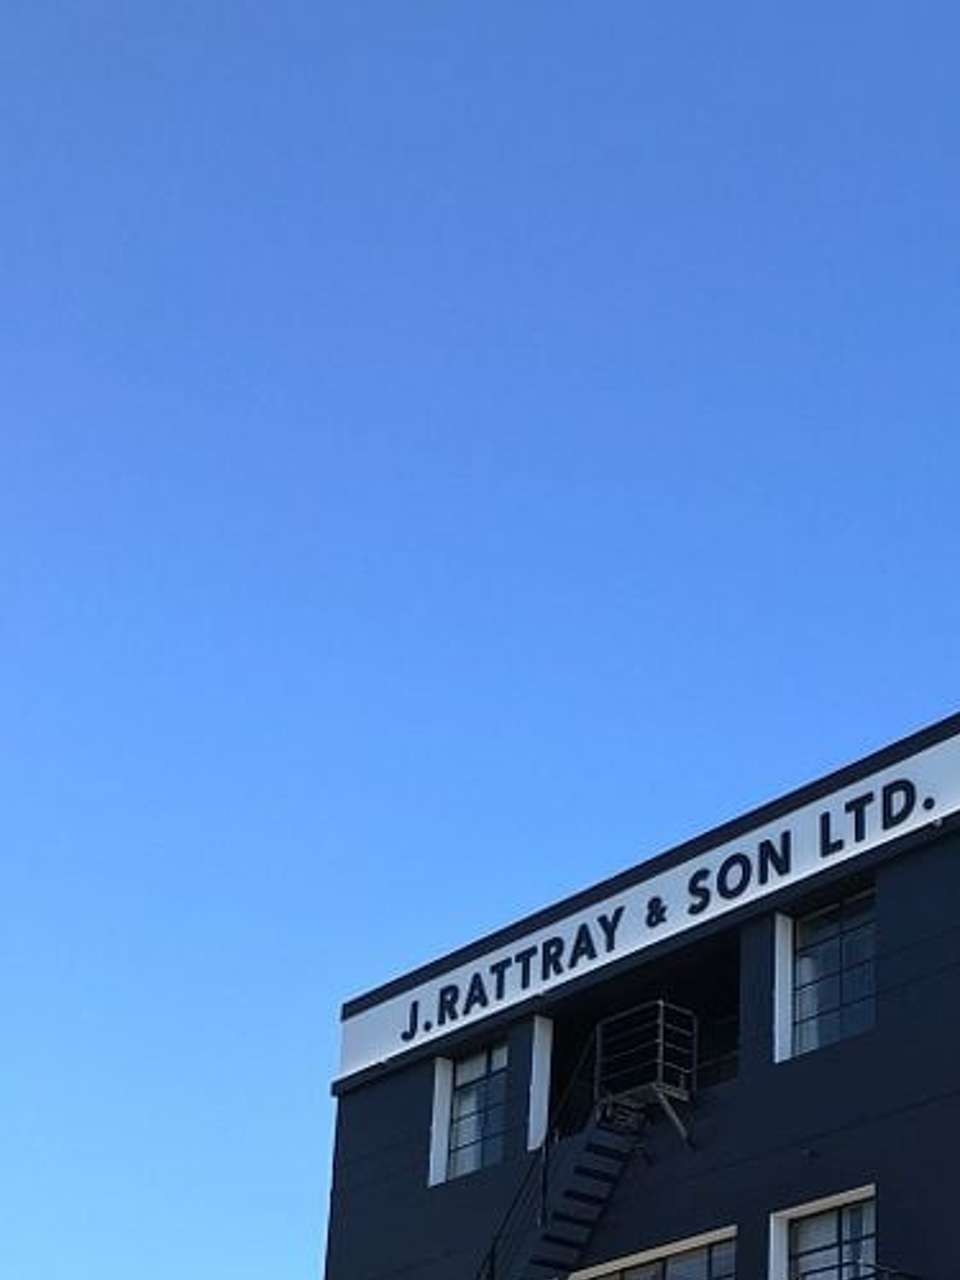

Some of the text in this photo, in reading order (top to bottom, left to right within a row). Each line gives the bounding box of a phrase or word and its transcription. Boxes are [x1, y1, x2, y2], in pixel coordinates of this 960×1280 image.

[645, 895, 668, 929] &
[687, 829, 792, 916] SON
[819, 778, 936, 859] LTD.
